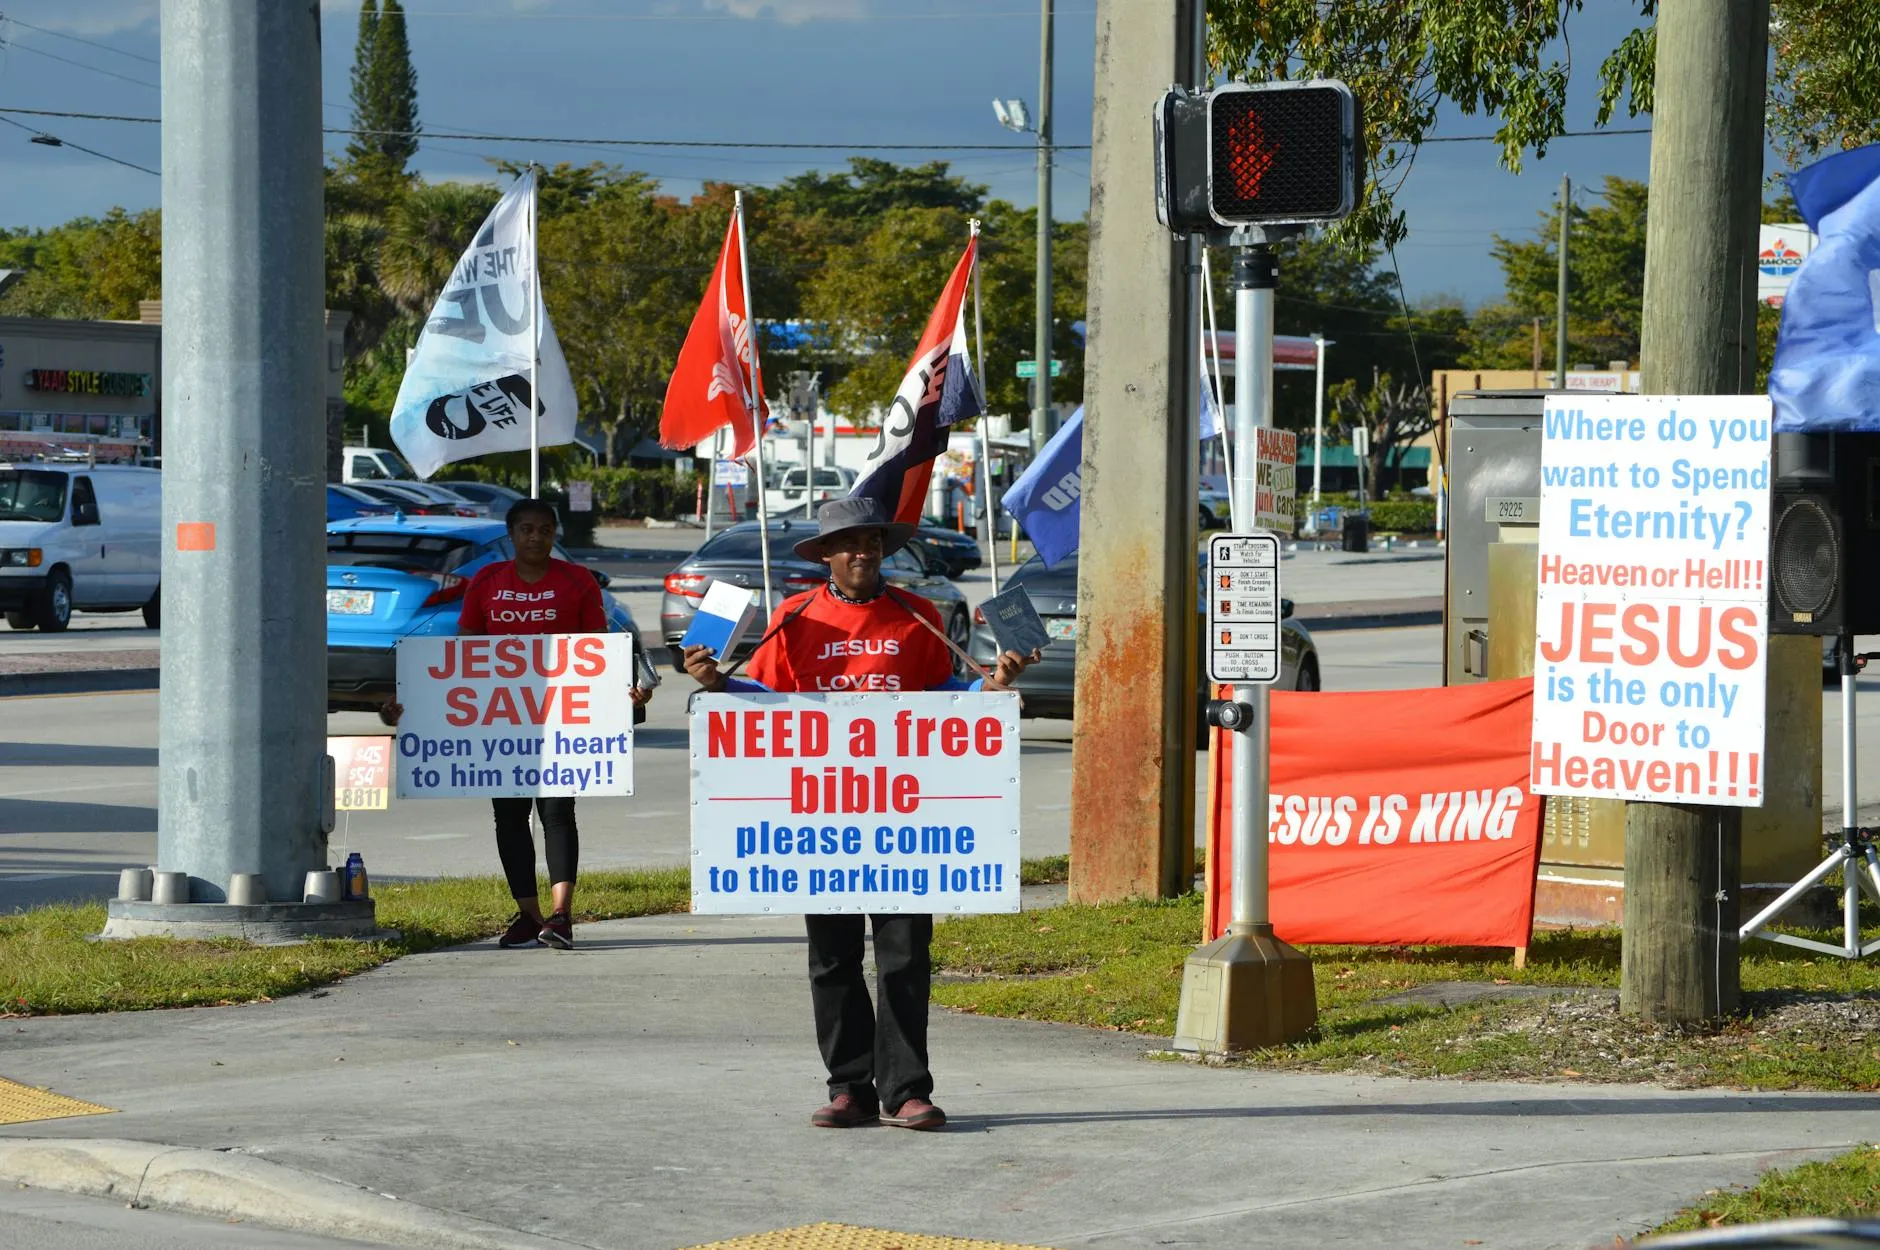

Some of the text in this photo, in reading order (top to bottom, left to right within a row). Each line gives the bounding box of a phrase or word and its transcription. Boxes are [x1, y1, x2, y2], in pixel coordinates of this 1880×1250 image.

[67, 369, 100, 394] STYLE
[479, 395, 517, 431] LIFE
[1545, 408, 1768, 448] Where do you
[1257, 461, 1293, 489] WE BUY
[1543, 458, 1768, 496] want to Spend
[1256, 485, 1294, 517] junk cars
[1499, 502, 1523, 517] 29225
[1569, 498, 1753, 550] Eternity?
[1541, 554, 1763, 590] Heaven or Hell!!
[492, 590, 555, 602] JESUS
[491, 609, 557, 623] LOVES
[817, 639, 900, 661] JESUS
[1540, 602, 1759, 671] JESUS
[427, 637, 606, 680] JESUS
[816, 673, 901, 691] LOVES
[1547, 667, 1739, 718] is the only
[445, 685, 591, 727] SAVE
[400, 730, 628, 763] Open your heart
[708, 709, 1003, 758] NEED a free
[1583, 711, 1711, 749] Door to
[412, 760, 613, 791] to him today!!
[1532, 741, 1760, 799] Heaven!!!
[791, 766, 920, 814] bible
[1269, 786, 1524, 846] ESUS IS KING
[736, 821, 975, 859] please come
[709, 864, 1003, 896] to the parking lot!!
